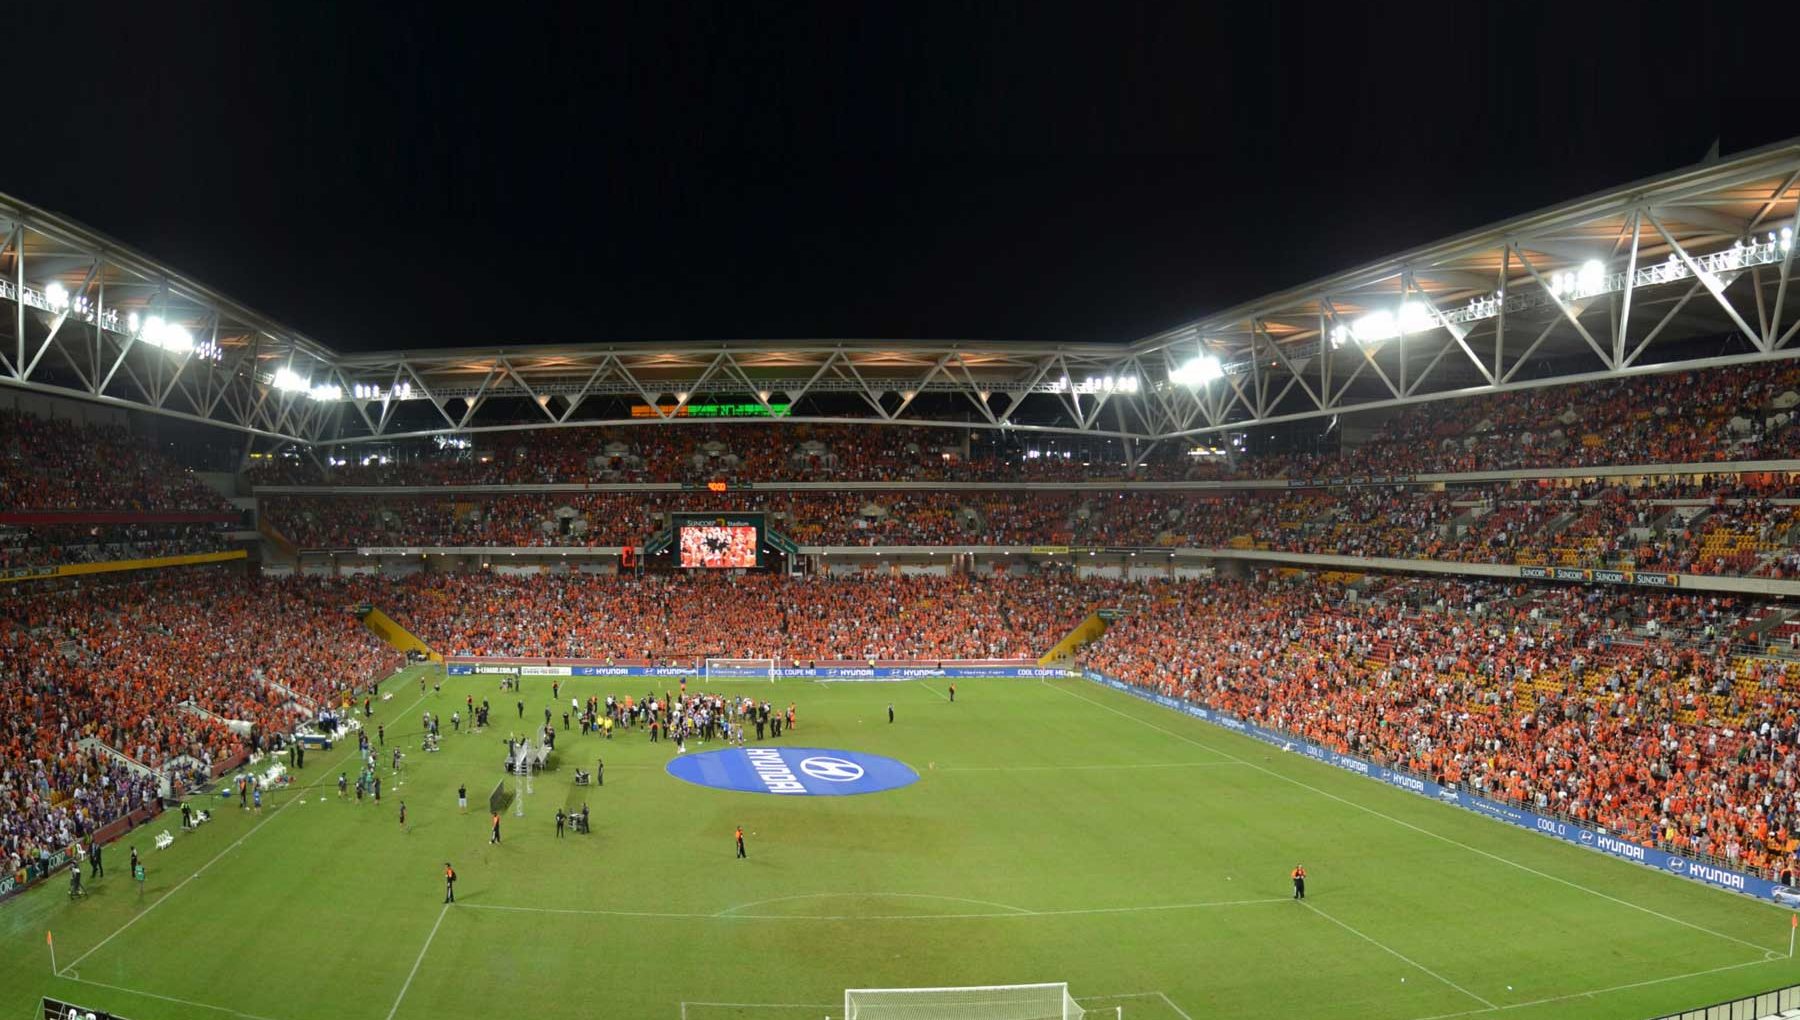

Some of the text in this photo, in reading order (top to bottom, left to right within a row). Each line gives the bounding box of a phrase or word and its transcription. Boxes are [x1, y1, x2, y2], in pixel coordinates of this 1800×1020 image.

[1522, 568, 1546, 578] SUNCORP
[1557, 569, 1583, 580] SUNCORP
[1596, 571, 1622, 583] SUNCORP
[1637, 574, 1666, 585] SUNCORP
[596, 667, 628, 675] HYUNDAI
[1017, 668, 1032, 676] COOL
[746, 748, 807, 793] HYUNDAI
[1341, 757, 1368, 773] HYUNDAI
[1393, 773, 1424, 791] HYUNDAI
[1537, 818, 1556, 833] COOL
[1597, 836, 1645, 859] HYUNDAI
[1690, 863, 1744, 888] HYUNDAI
